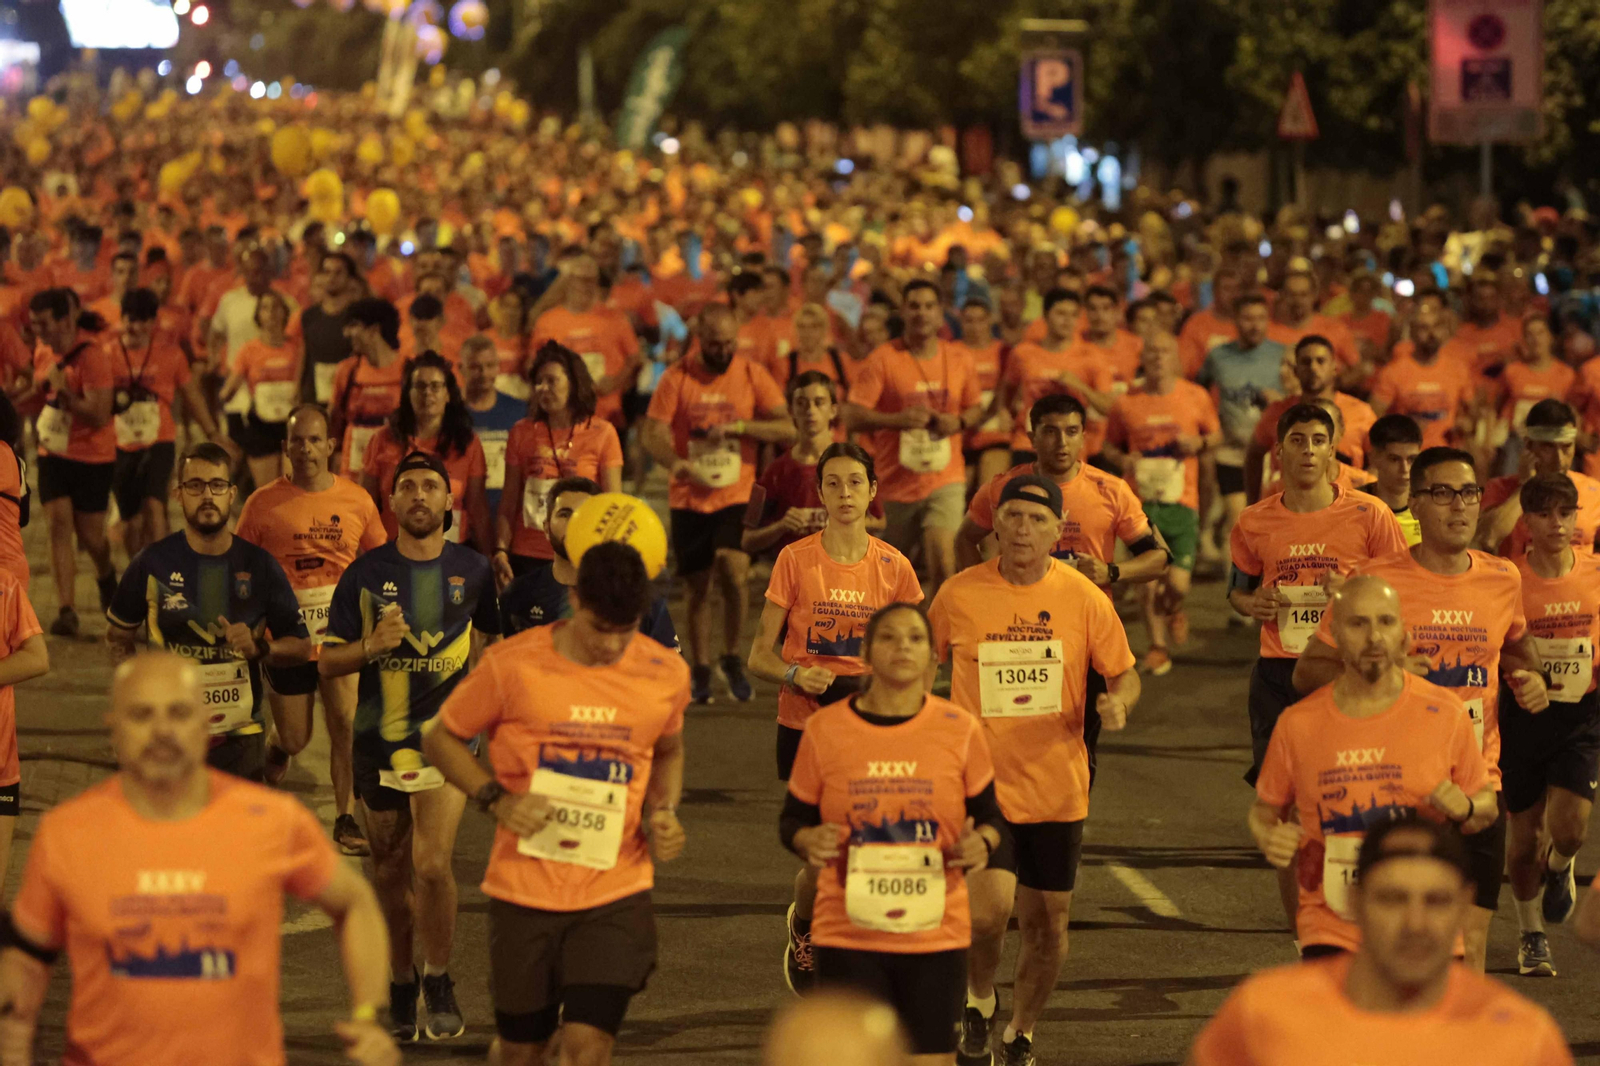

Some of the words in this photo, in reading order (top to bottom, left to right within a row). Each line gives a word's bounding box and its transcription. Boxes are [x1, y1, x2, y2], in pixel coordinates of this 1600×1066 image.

[293, 533, 324, 541] SEVILLA
[1290, 544, 1326, 556] XXXV
[1280, 562, 1339, 571] GUADALQUIVIR
[829, 588, 866, 603] XXXV
[817, 607, 871, 619] GUADALQUIV
[845, 603, 877, 611] NOCTURNA
[1544, 601, 1581, 615] XXXV
[1432, 609, 1474, 625] XXXV
[985, 633, 1026, 642] SEVILLA
[1007, 626, 1053, 635] NOCTURNA
[1419, 633, 1488, 642] GUADALQUIVIR
[378, 656, 464, 672] VOZIFIBRA
[996, 668, 1049, 684] 13045
[570, 705, 617, 722] XXXV
[1337, 747, 1385, 766] XXXV
[867, 761, 917, 777] XXXV
[545, 806, 606, 831] 0358
[868, 878, 927, 895] 16086
